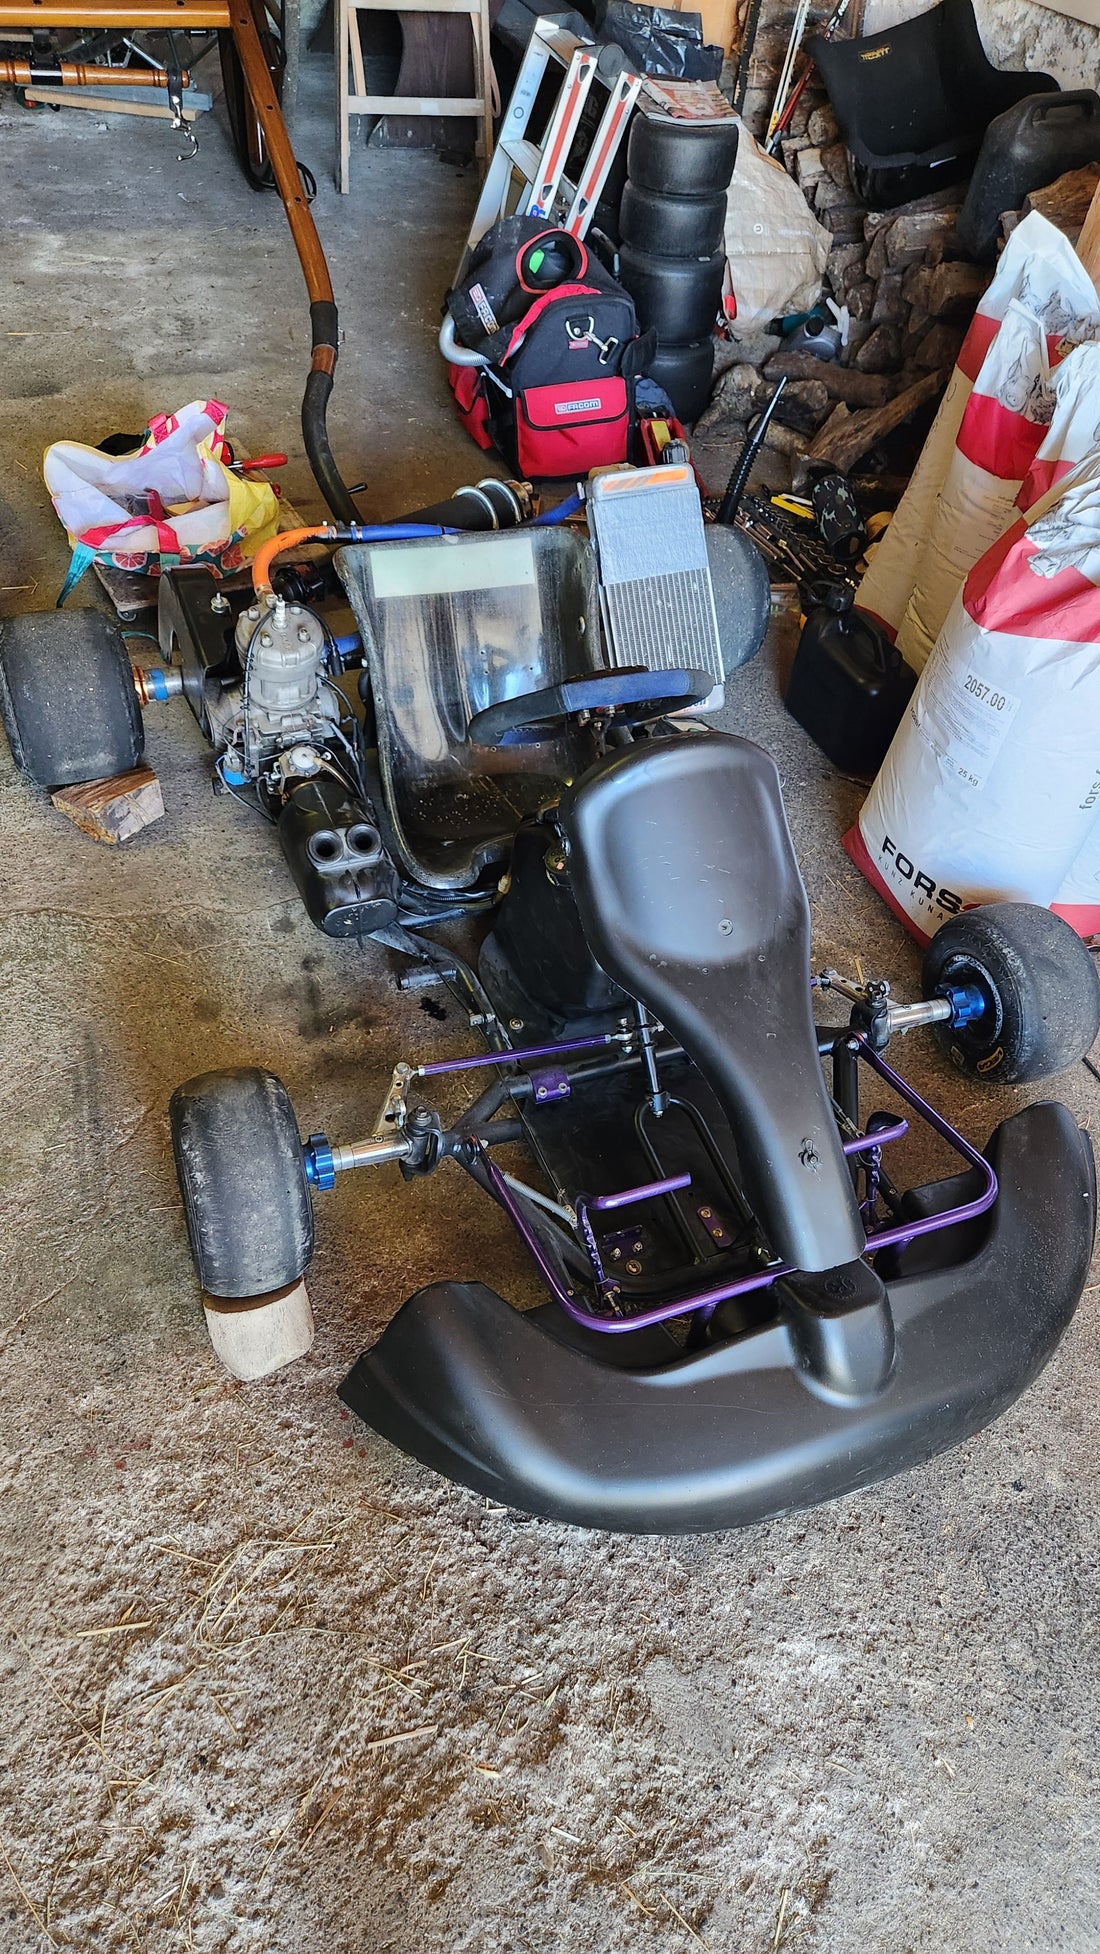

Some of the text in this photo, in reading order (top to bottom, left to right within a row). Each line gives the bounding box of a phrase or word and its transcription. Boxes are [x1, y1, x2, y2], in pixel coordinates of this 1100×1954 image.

[567, 400, 599, 412] FACOM
[964, 674, 1006, 711] 2057.00
[958, 767, 979, 787] 25 kg
[878, 854, 947, 921] KUNZ KUNA
[882, 835, 963, 915] FORS
